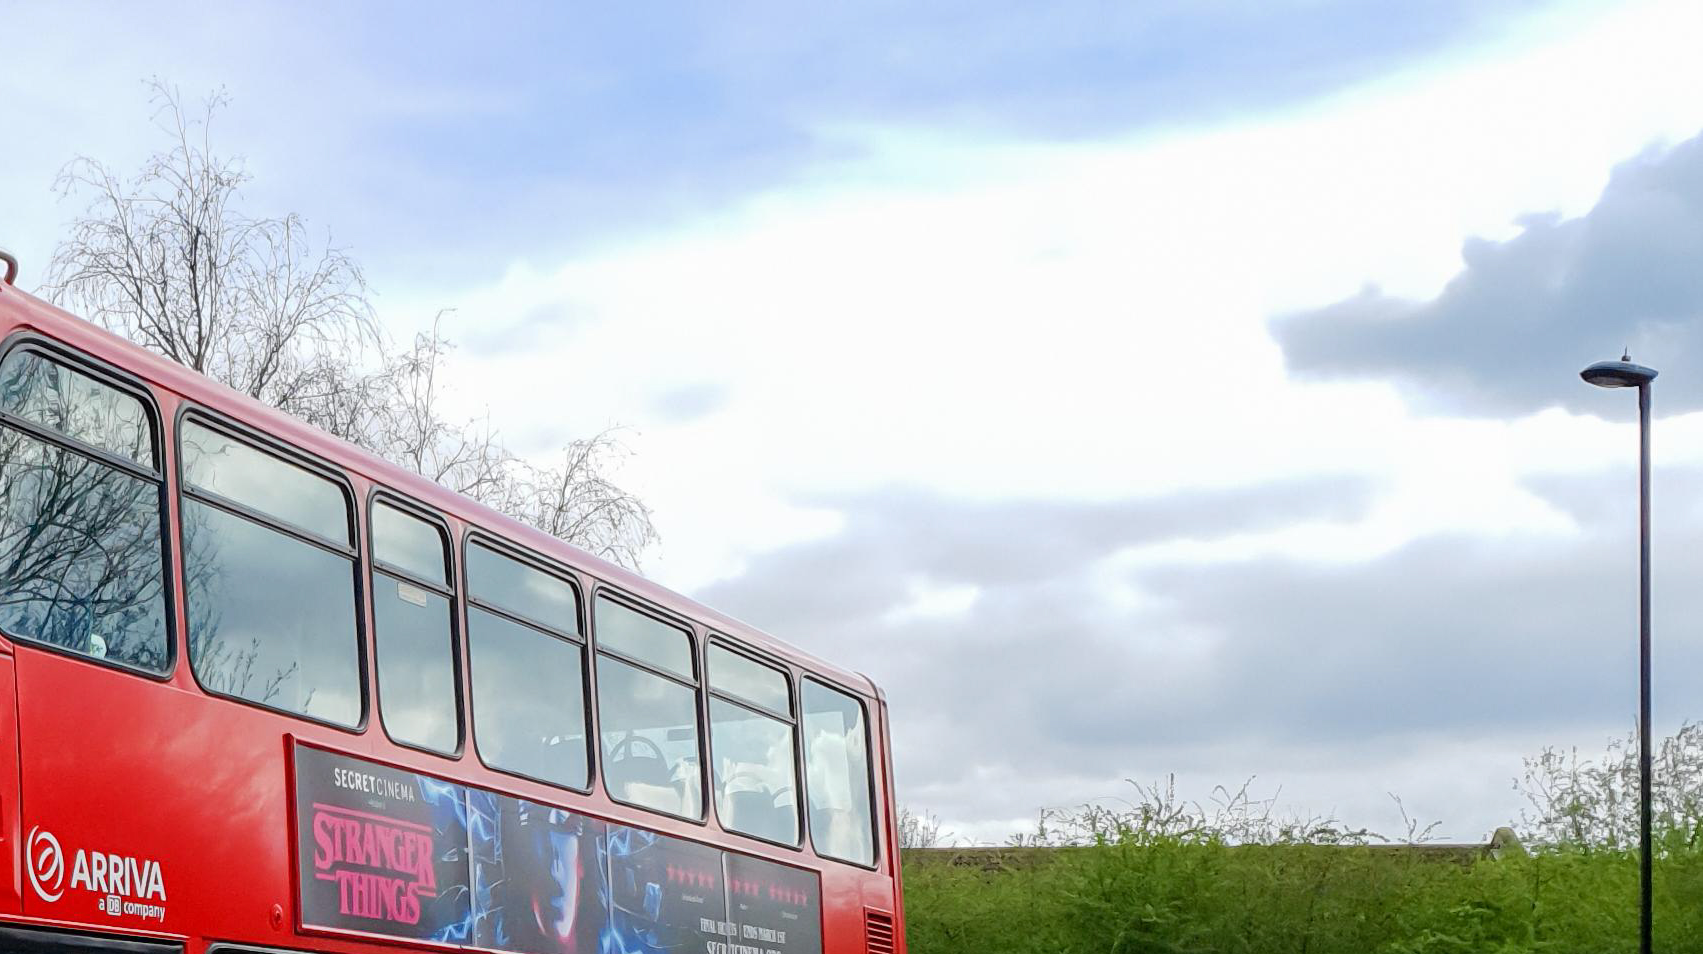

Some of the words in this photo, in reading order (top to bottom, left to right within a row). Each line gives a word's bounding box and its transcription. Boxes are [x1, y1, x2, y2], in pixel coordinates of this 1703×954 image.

[71, 848, 166, 901] ARRIVA
[313, 811, 436, 889] STRANGER
[99, 898, 105, 911] a
[124, 902, 165, 923] company
[336, 870, 420, 925] THINGS
